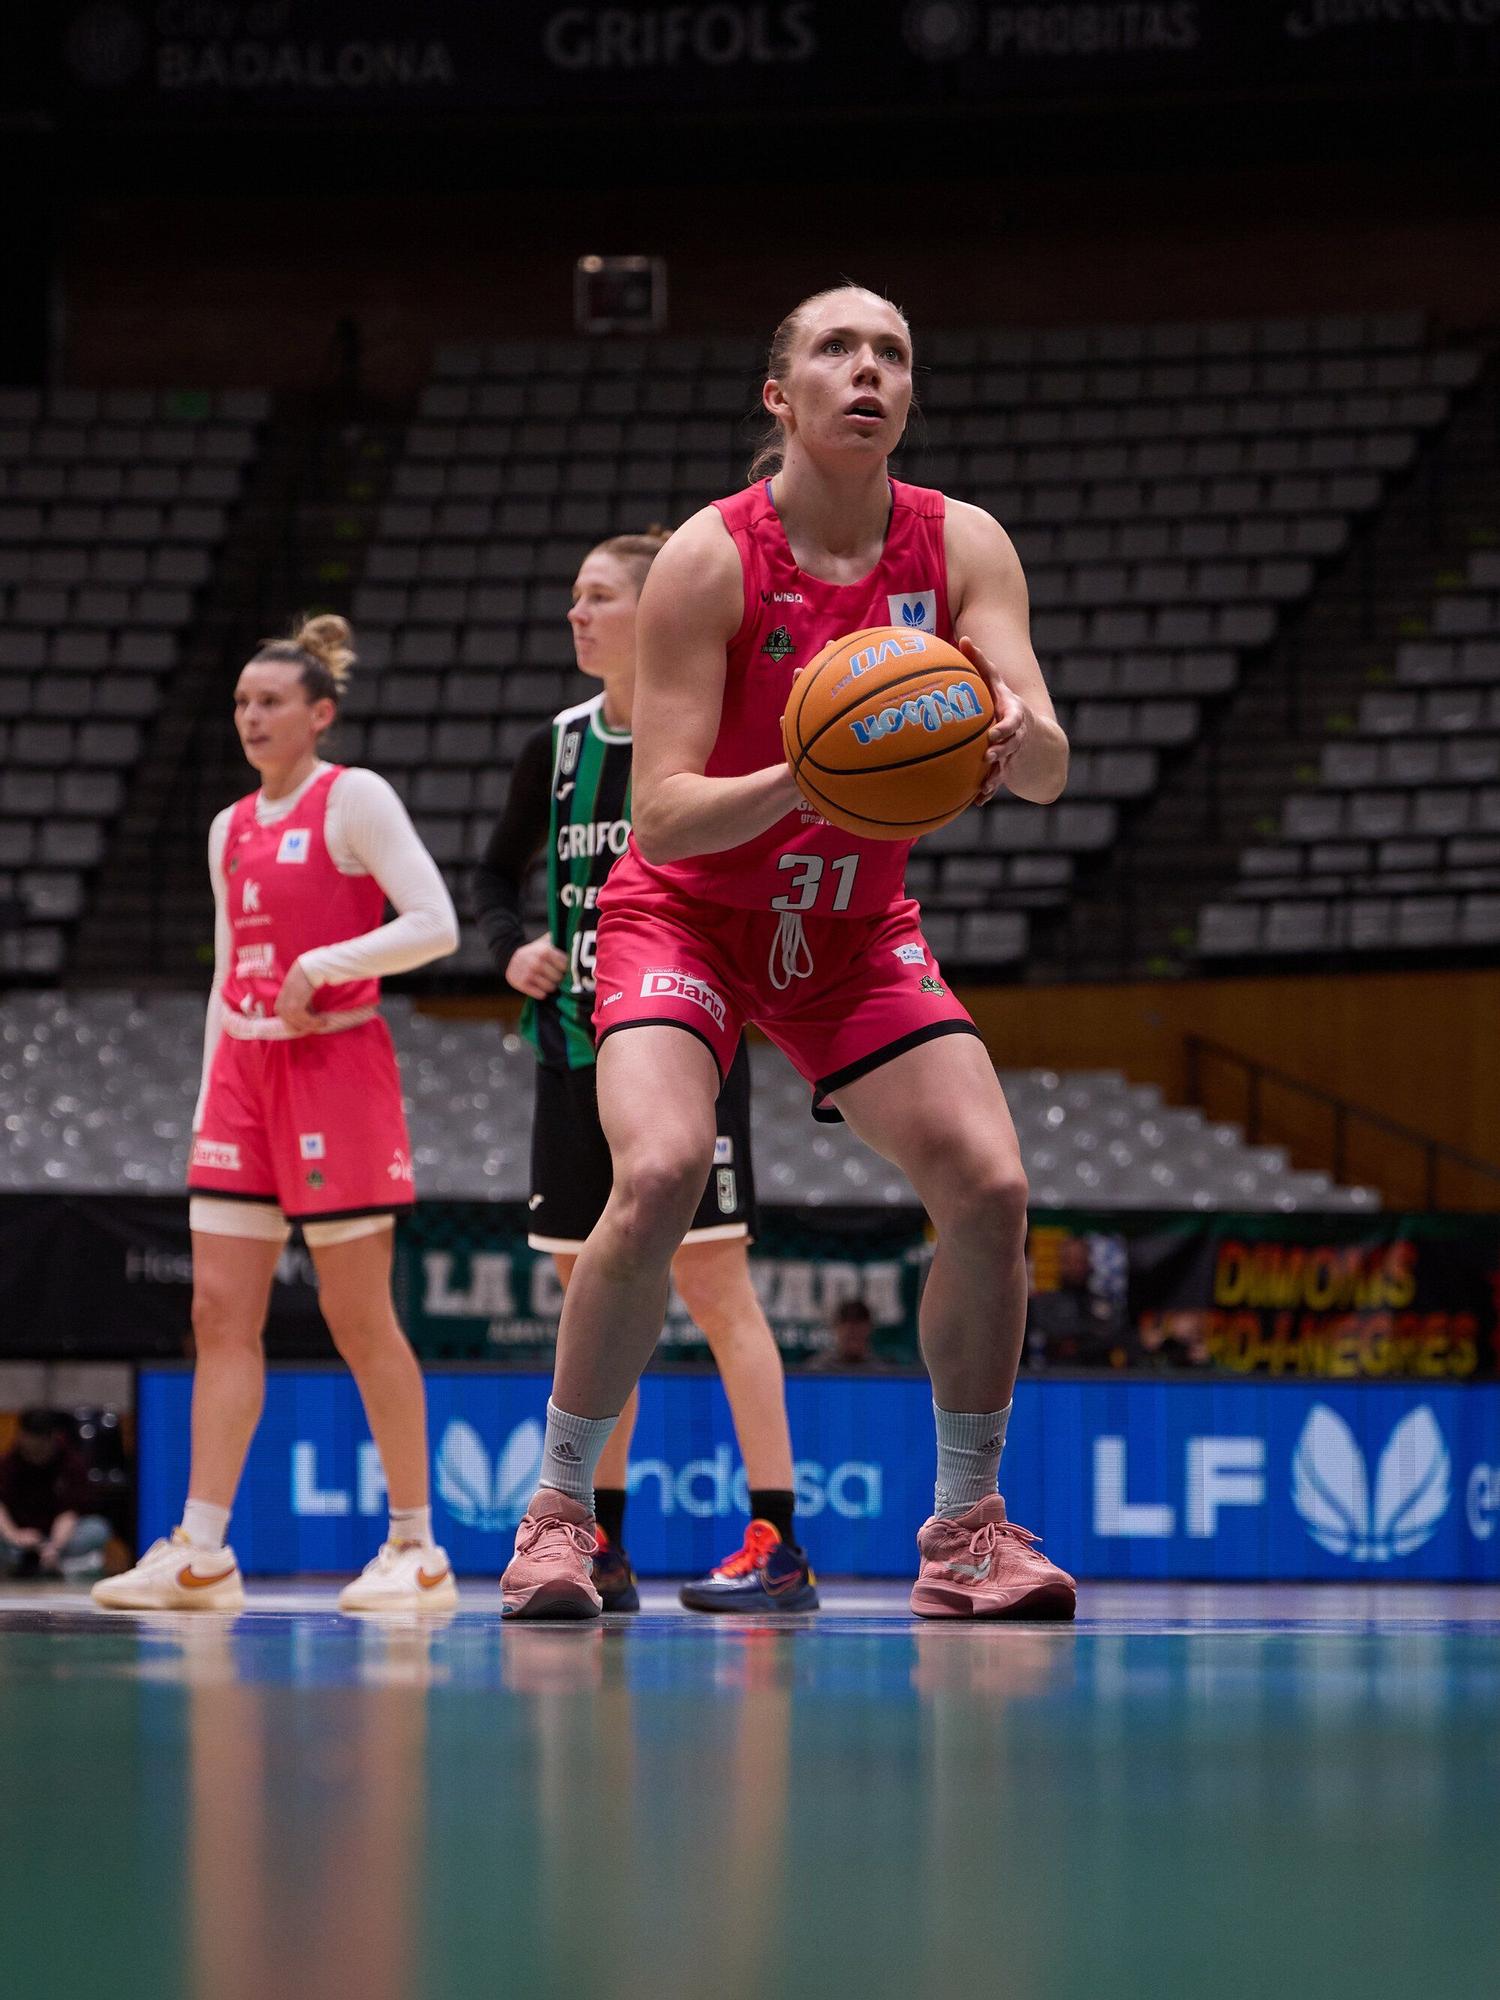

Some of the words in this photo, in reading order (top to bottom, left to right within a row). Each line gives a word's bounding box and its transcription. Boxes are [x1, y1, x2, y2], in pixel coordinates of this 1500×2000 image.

[541, 5, 816, 69] GRIFOLS
[988, 4, 1198, 56] PROBITAS
[156, 43, 455, 89] BADALONA
[850, 635, 927, 678] EVO
[849, 681, 985, 745] Wilson
[558, 819, 633, 860] GRIFO
[771, 853, 860, 911] 31
[651, 976, 723, 1020] Diario
[626, 1443, 883, 1519] ndsa
[1092, 1435, 1267, 1538] LF
